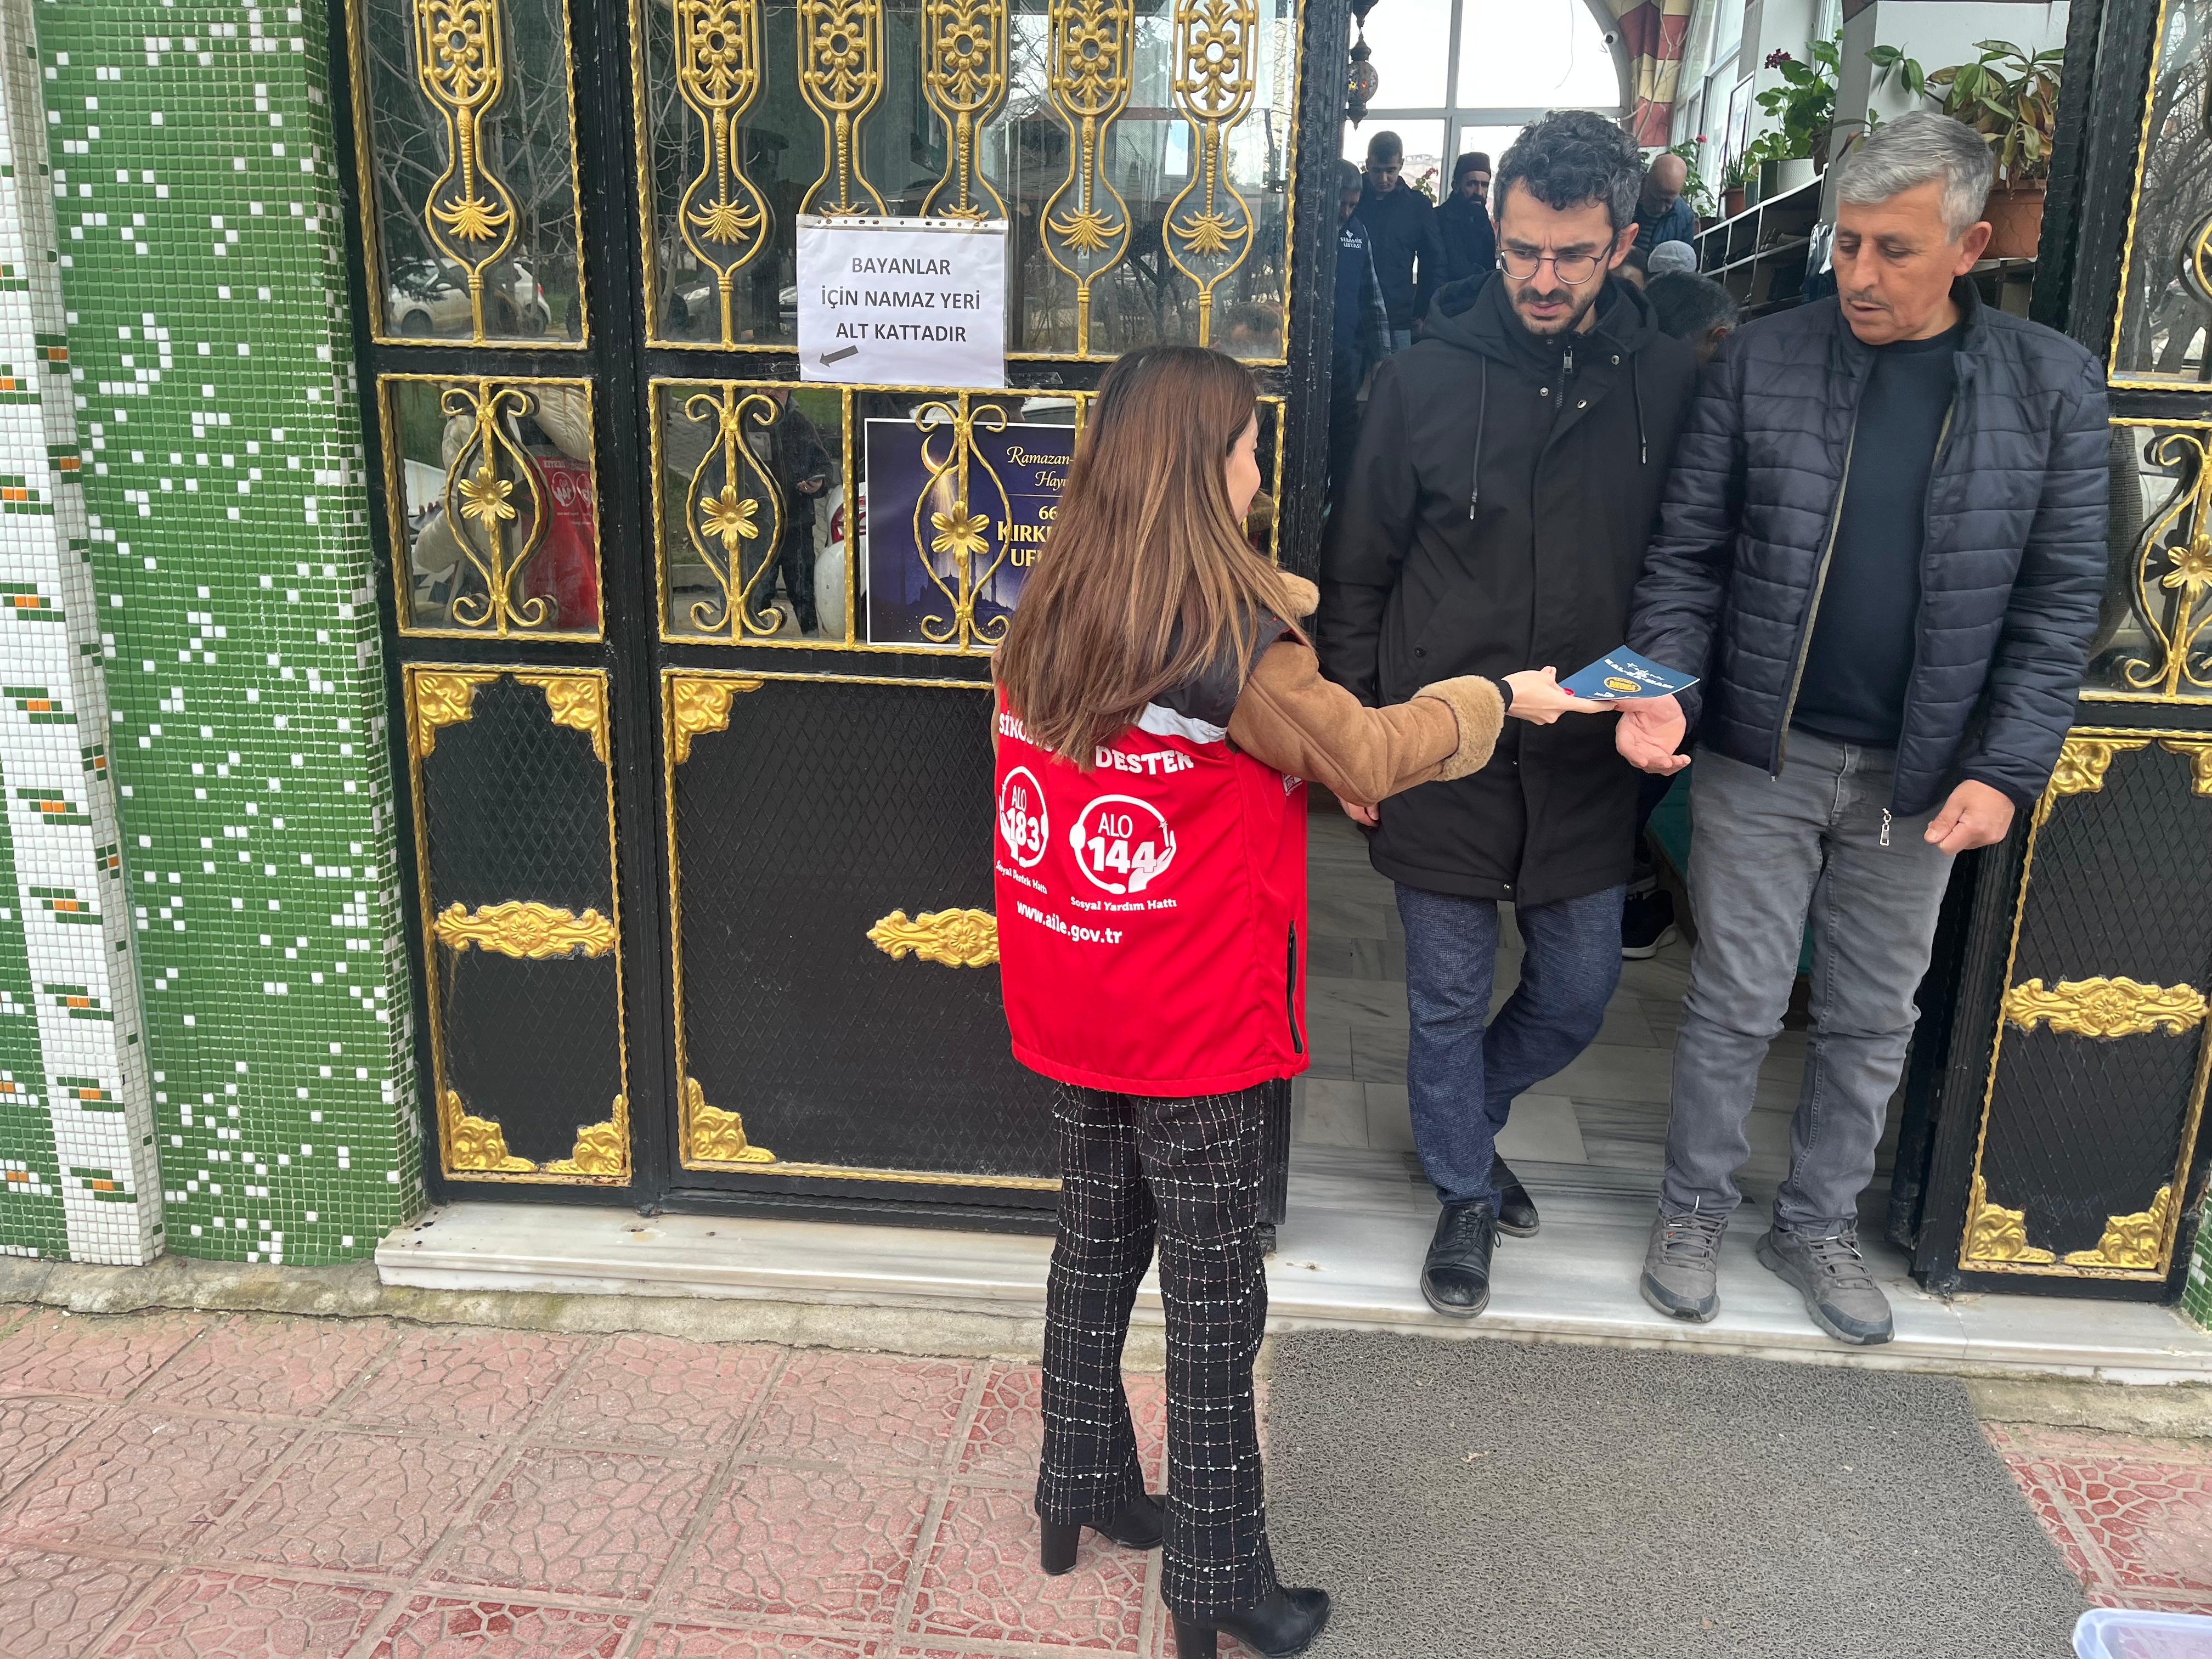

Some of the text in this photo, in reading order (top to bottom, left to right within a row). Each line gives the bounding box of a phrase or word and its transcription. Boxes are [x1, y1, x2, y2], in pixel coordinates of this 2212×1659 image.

[852, 257, 951, 275] BAYANLAR
[822, 285, 980, 309] İÇİN NAMAZ YERİ
[836, 323, 967, 342] ALT KATTADIR
[1095, 745, 1194, 775] DESTEK
[1011, 785, 1027, 812] ALO
[1006, 807, 1040, 852] 183
[1097, 812, 1133, 839] ALO
[1087, 836, 1157, 874] 144
[1013, 869, 1031, 887] Destek
[1070, 896, 1177, 912] Sosyal Yardım Hattı
[1017, 900, 1122, 944] www.aile.gov.tr
